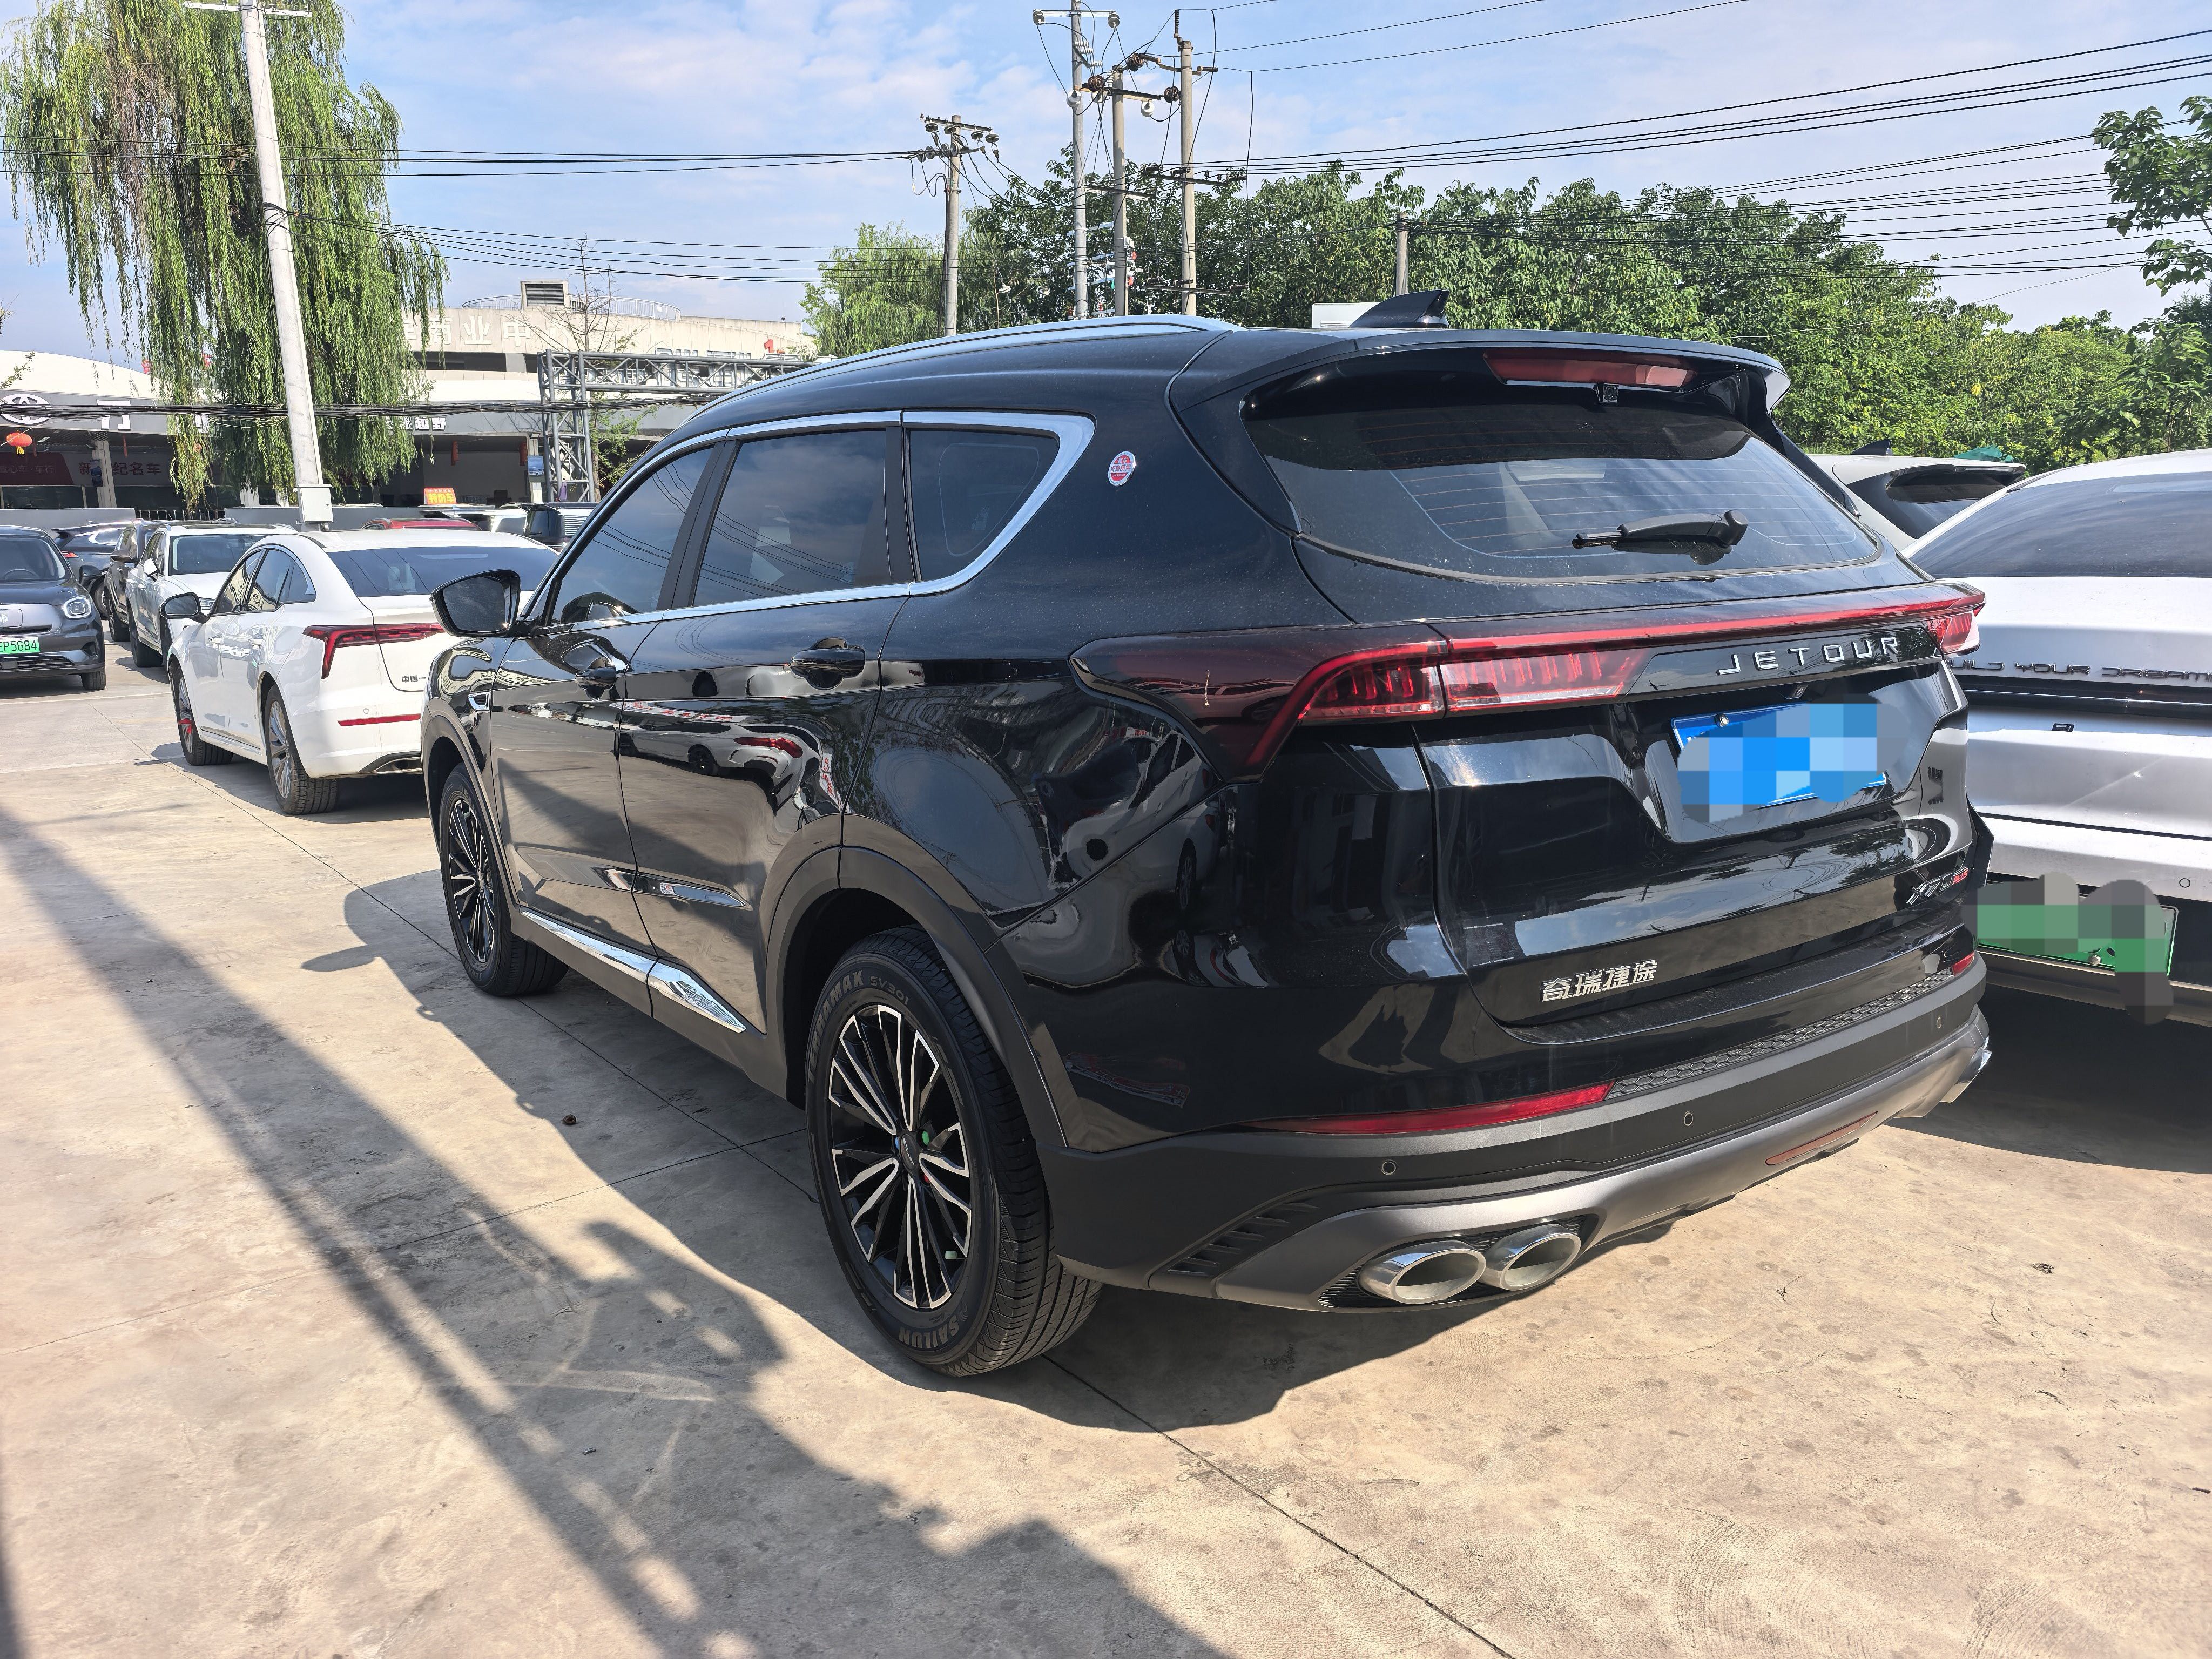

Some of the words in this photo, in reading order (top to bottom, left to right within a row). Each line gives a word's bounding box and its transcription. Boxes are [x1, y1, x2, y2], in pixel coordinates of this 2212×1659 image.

[78, 462, 162, 476] 新纪名车
[1716, 637, 1898, 676] JETOUR
[1945, 659, 2005, 671] UILD
[2015, 662, 2090, 675] YOUR
[2101, 666, 2212, 683] DREAM
[1540, 959, 1658, 1002] 奇瑞捷途
[808, 970, 864, 1085] TERRAMAX
[869, 975, 909, 1006] SV301
[899, 1314, 960, 1349] SAILUN
